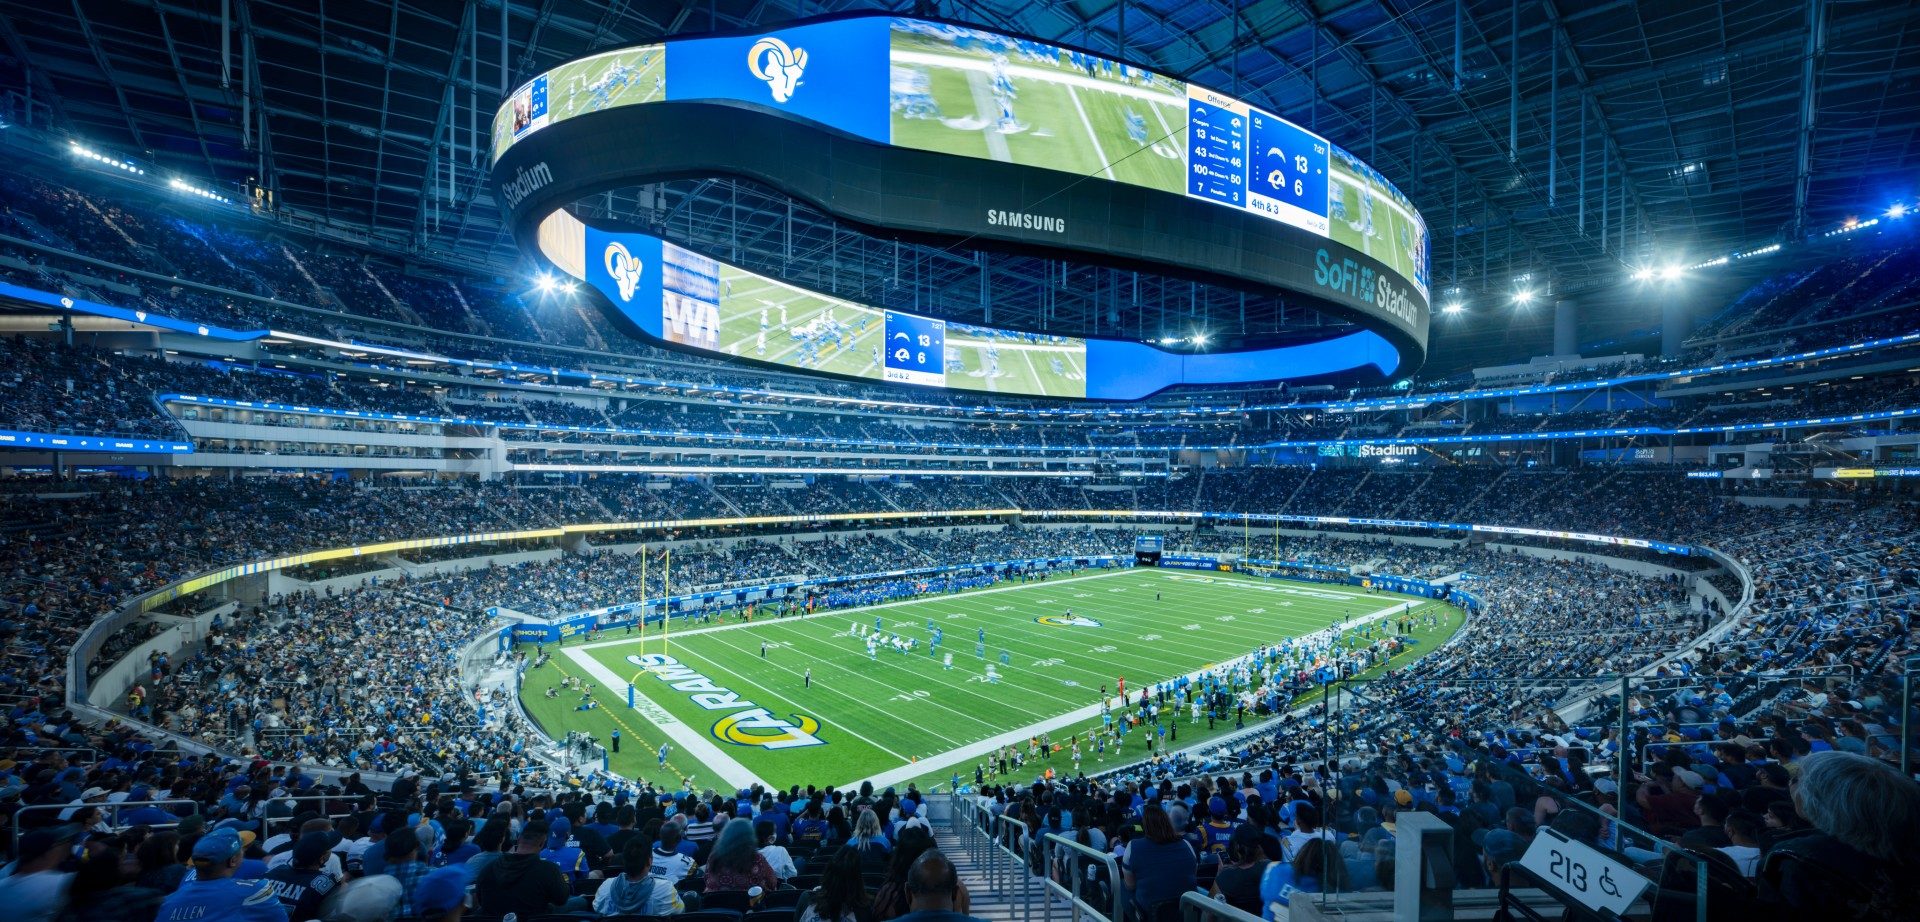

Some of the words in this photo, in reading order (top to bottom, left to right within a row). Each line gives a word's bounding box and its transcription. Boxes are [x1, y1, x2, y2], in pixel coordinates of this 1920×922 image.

[1207, 94, 1231, 108] Offense
[1196, 128, 1206, 139] 13
[1231, 140, 1240, 150] 14
[1194, 147, 1207, 157] 43
[1230, 157, 1241, 167] 46
[1294, 155, 1308, 174] 13
[1193, 164, 1208, 175] 100
[1230, 174, 1241, 185] 50
[502, 161, 553, 209] Stadium
[1197, 182, 1203, 192] 7
[1232, 191, 1238, 201] 3
[1294, 179, 1303, 197] 6
[1251, 198, 1265, 211] 4th
[1266, 203, 1273, 213] &
[1273, 205, 1279, 215] 3
[987, 209, 1065, 233] SAMSUNG
[1314, 248, 1358, 297] SoFi
[1377, 275, 1417, 328] Stadium
[918, 334, 930, 347] 13
[917, 352, 926, 364] 6
[1361, 444, 1417, 455] Stadium
[626, 653, 758, 710] RAMS
[1550, 849, 1588, 893] 213
[169, 905, 206, 921] ALLEN
